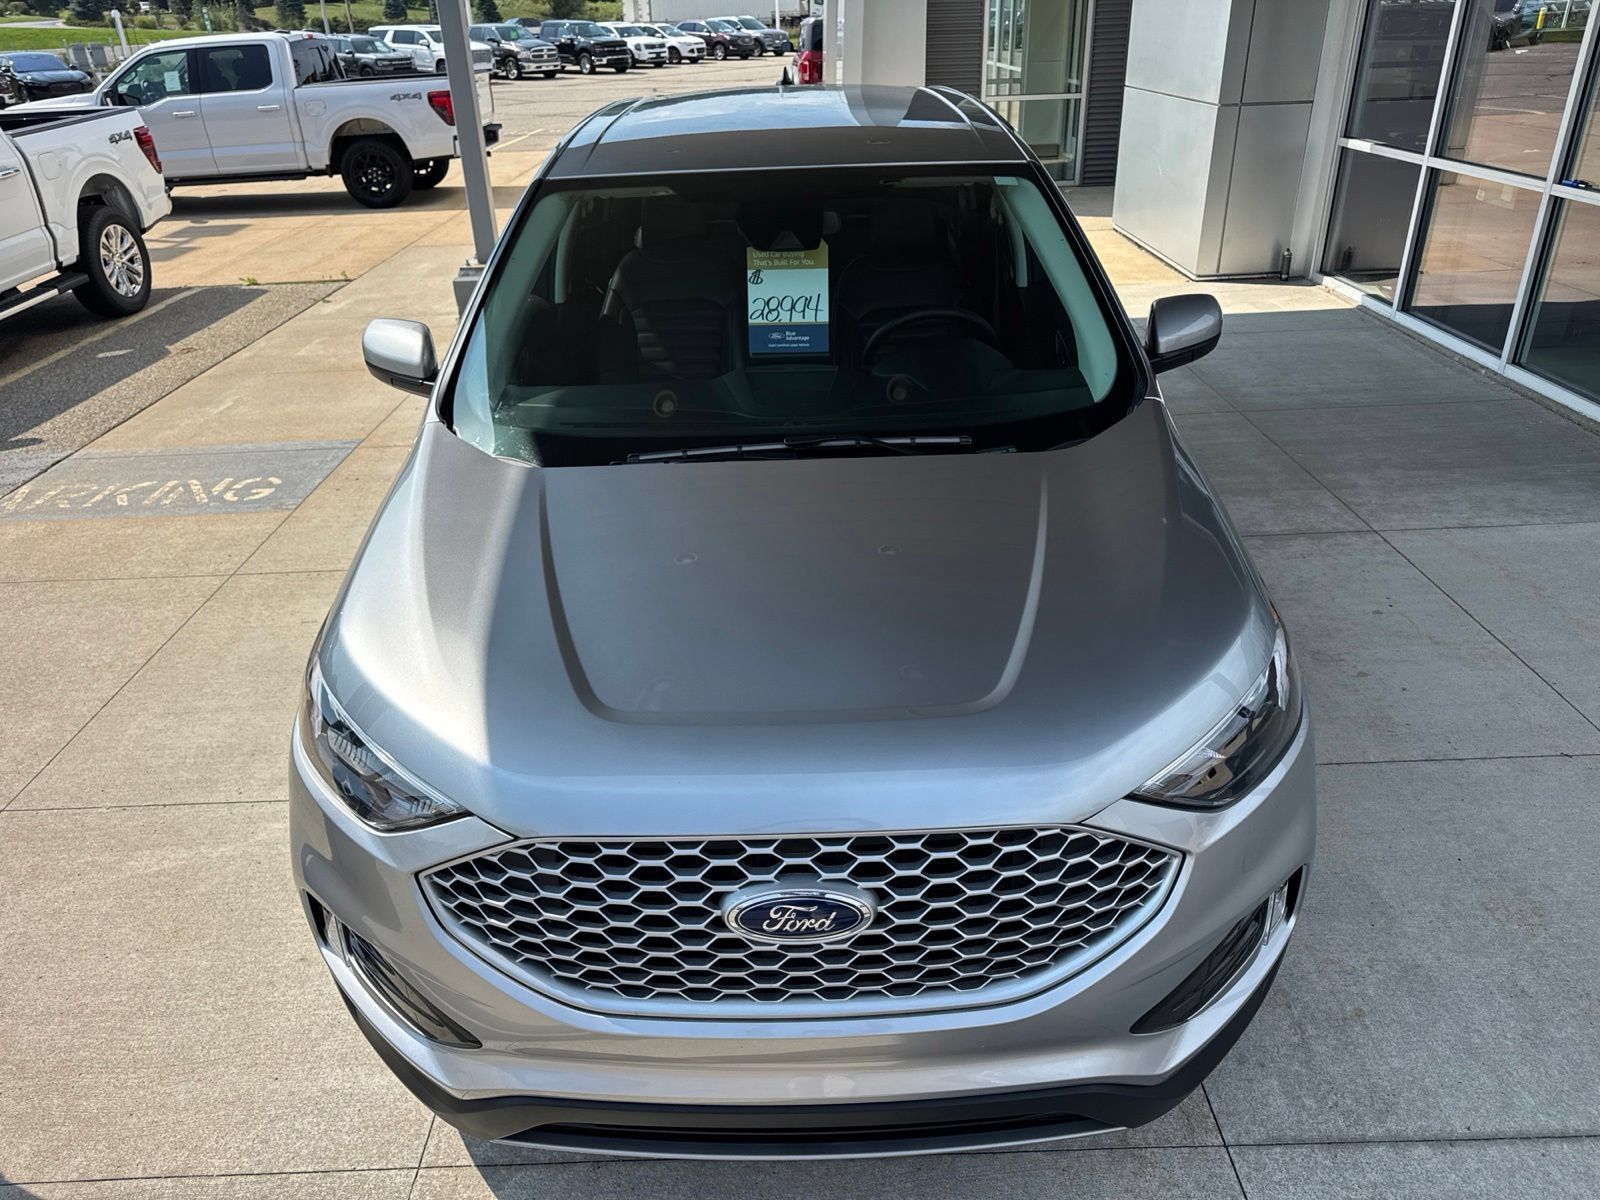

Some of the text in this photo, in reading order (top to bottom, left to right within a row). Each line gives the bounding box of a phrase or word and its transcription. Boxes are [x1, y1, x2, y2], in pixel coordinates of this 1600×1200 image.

[752, 250, 769, 258] Used
[748, 268, 764, 285] $
[762, 905, 837, 932] Ford
